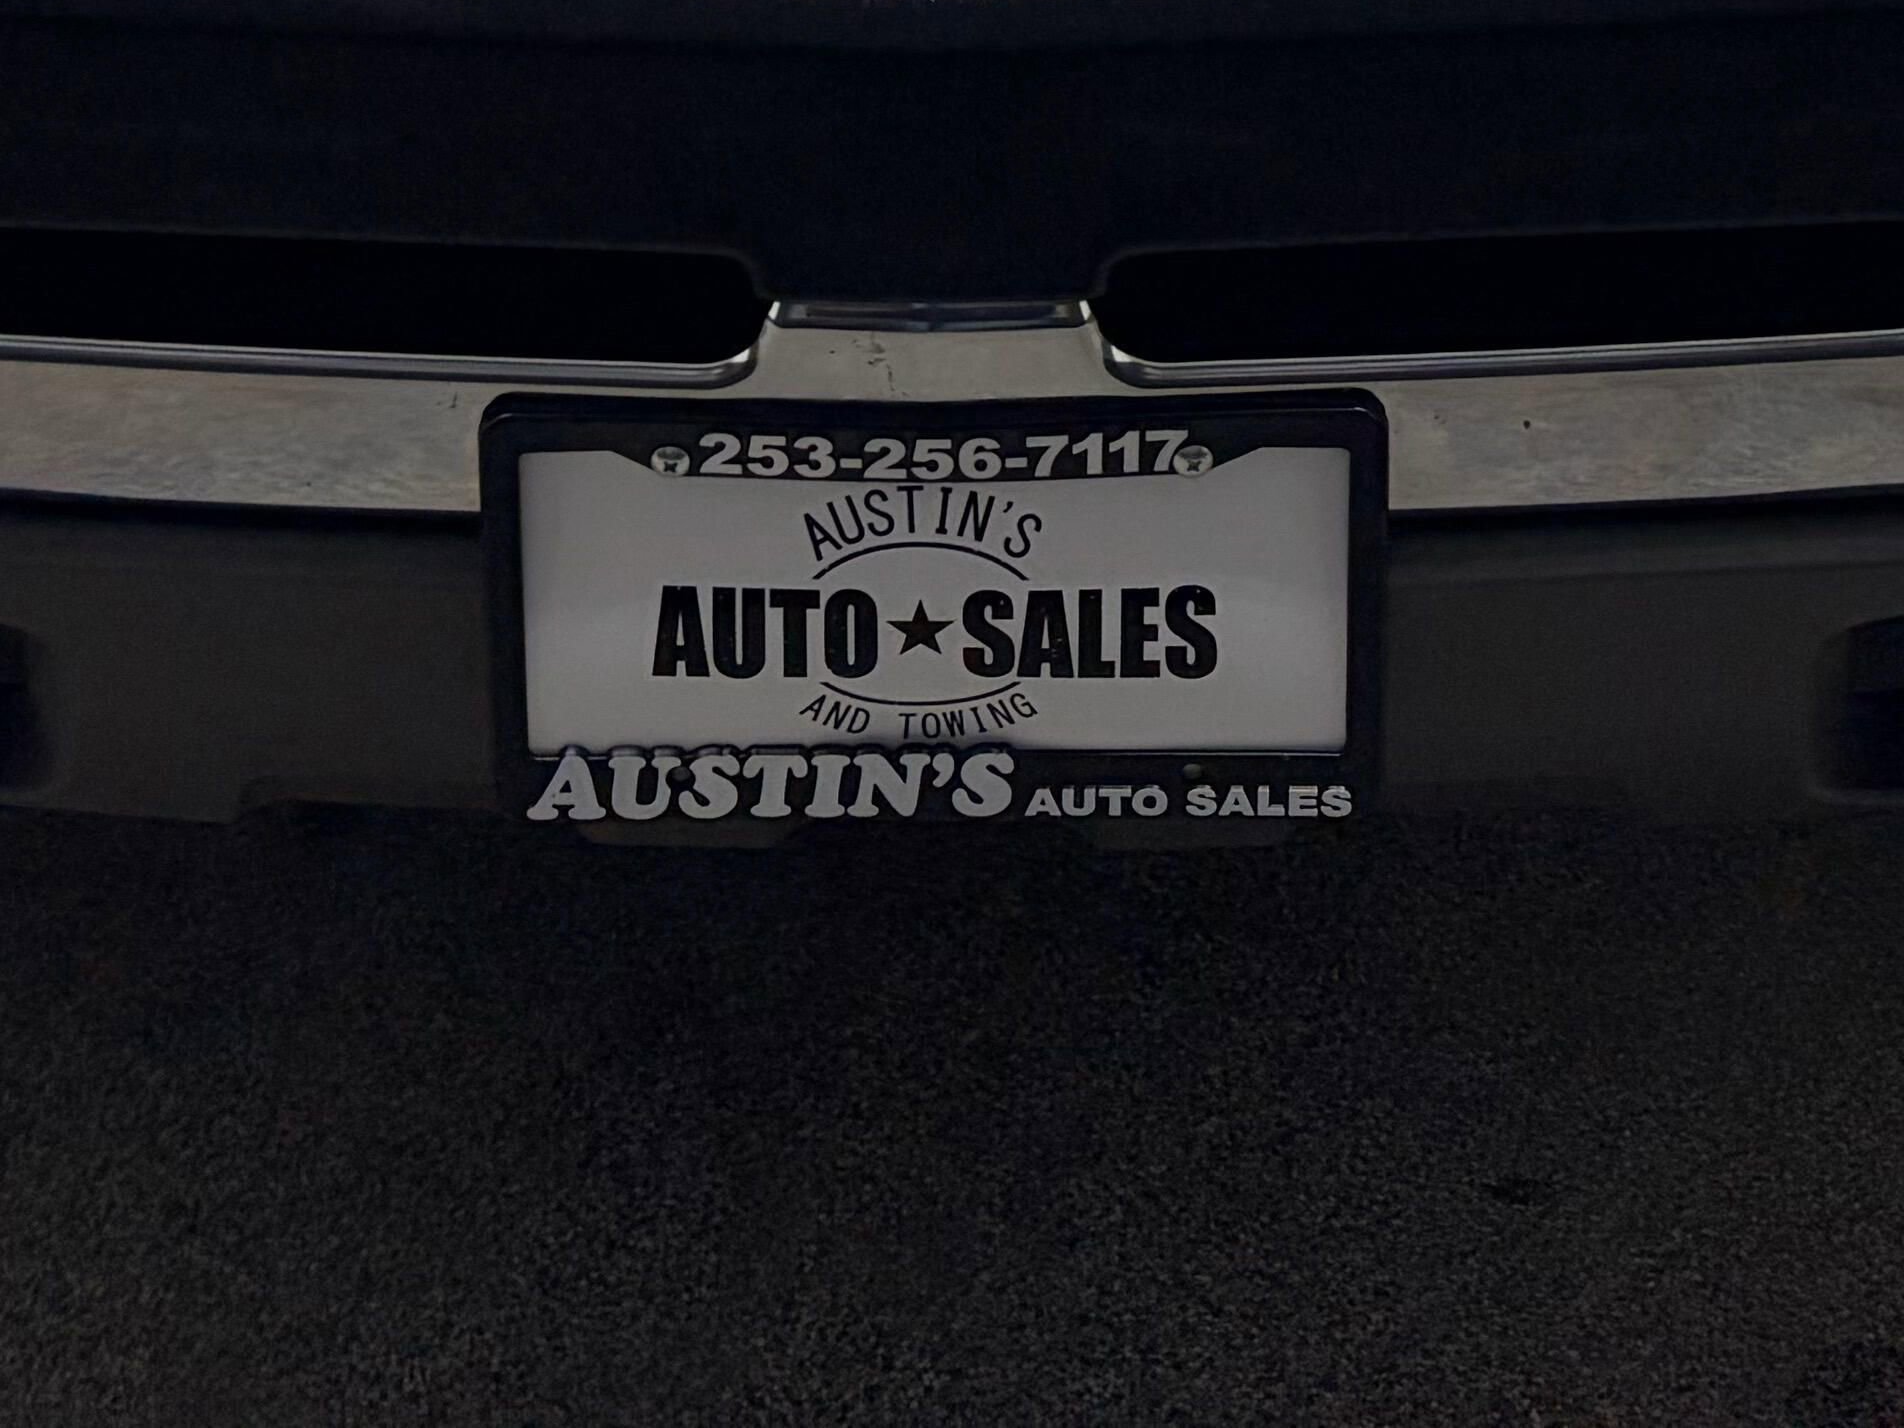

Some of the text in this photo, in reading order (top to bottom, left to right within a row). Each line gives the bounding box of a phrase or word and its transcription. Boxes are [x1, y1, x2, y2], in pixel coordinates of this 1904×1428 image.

[697, 429, 1188, 481] 253-256-7117
[802, 484, 1043, 562] AUSTIN'S
[651, 584, 1218, 680] AUTO SALES
[798, 691, 1039, 741] AND TOWING
[527, 749, 1354, 822] AUSTIN'S AUTO SALES
